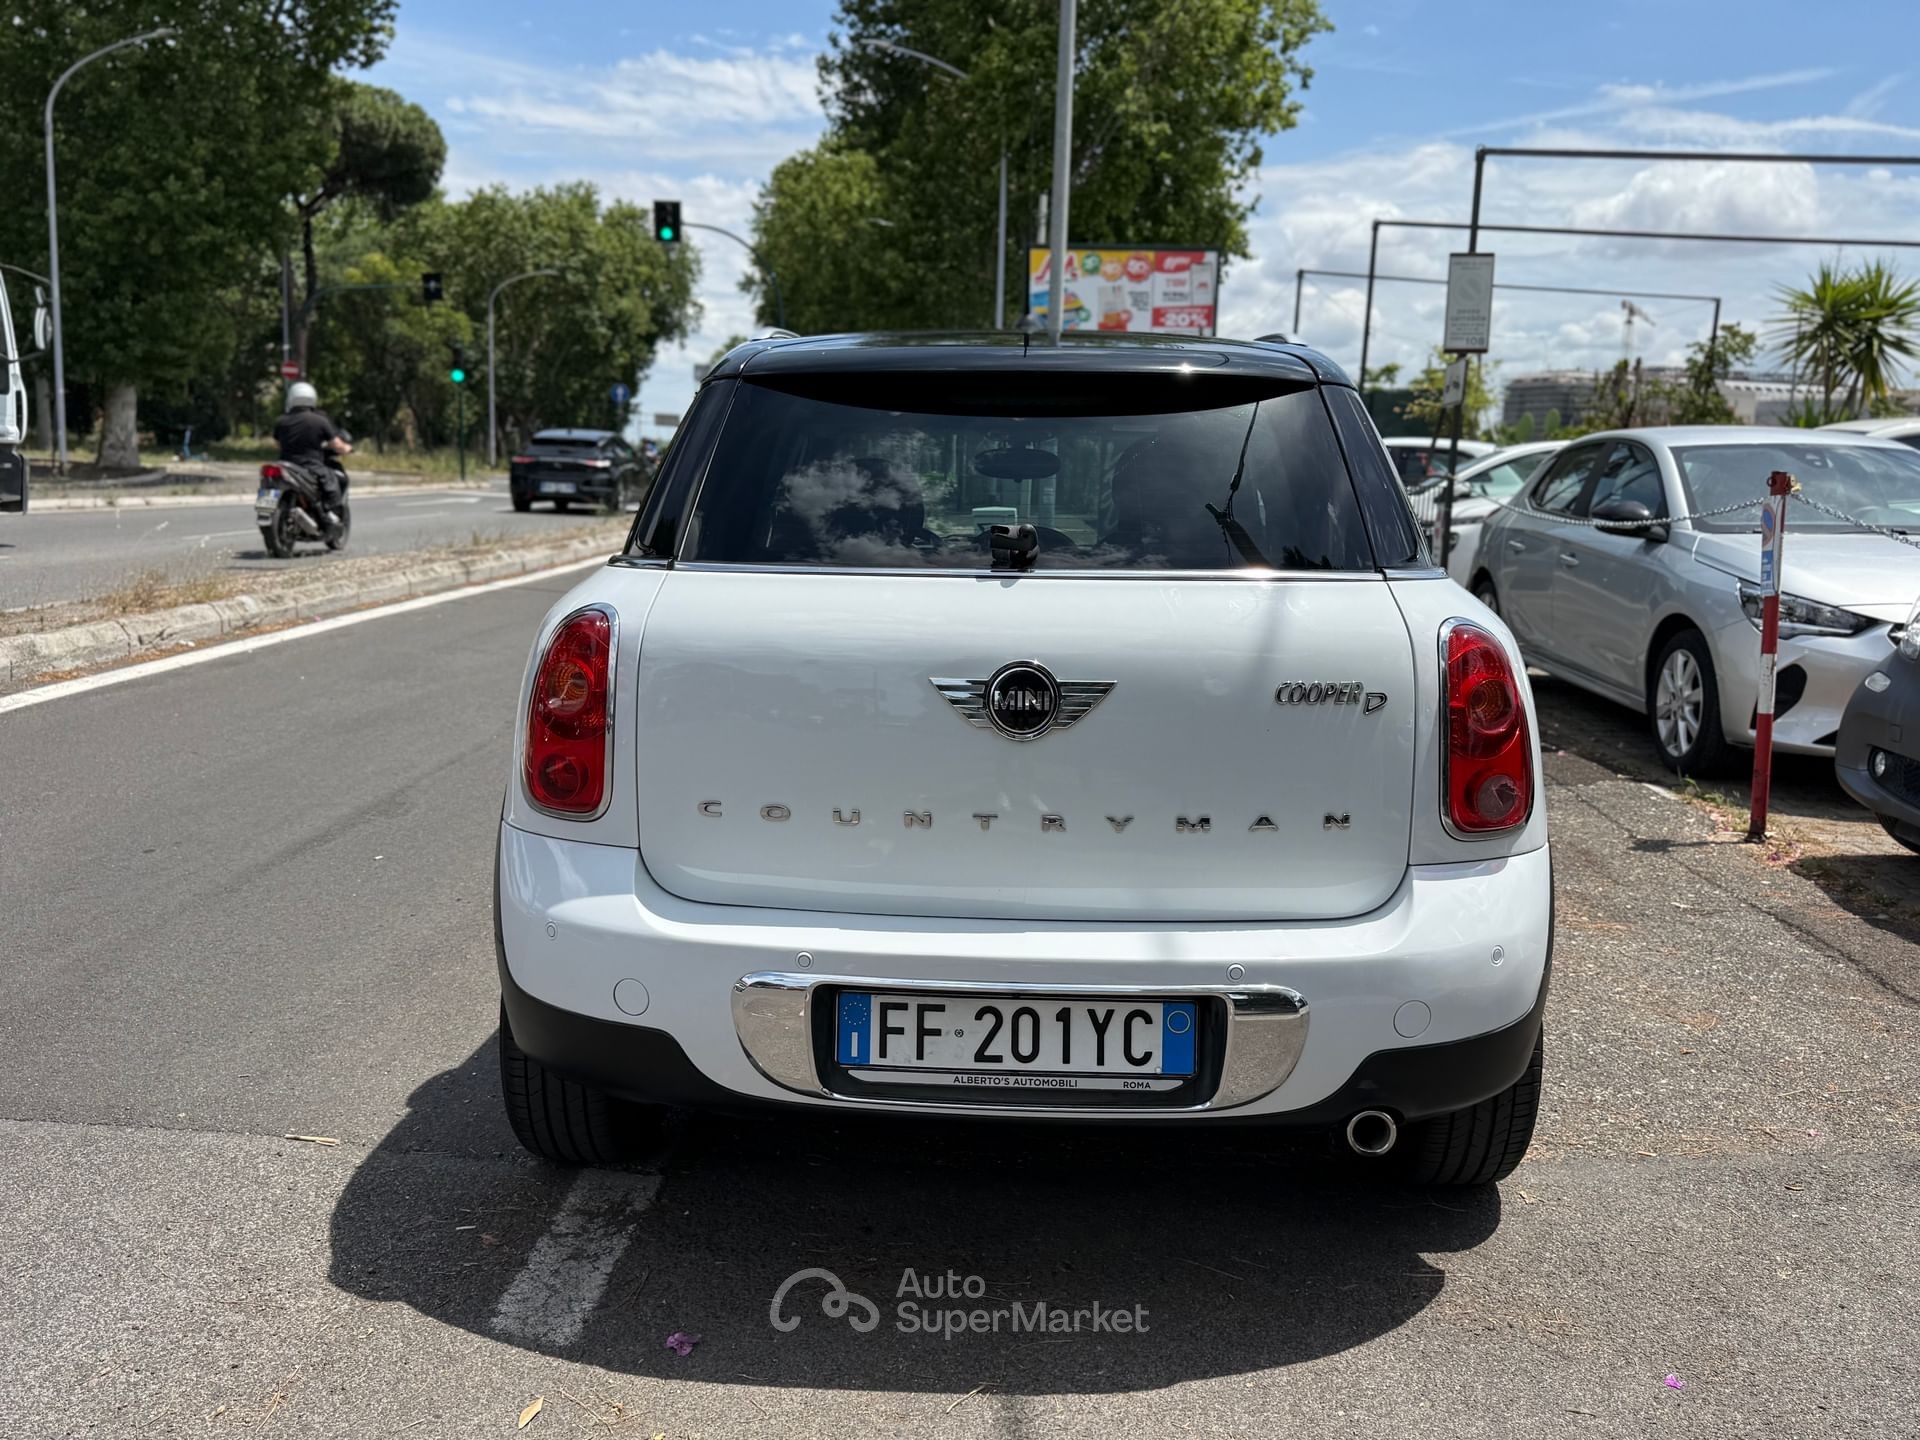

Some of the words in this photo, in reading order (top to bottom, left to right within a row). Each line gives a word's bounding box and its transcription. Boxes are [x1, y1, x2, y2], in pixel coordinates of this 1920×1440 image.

[994, 690, 1050, 711] MINI
[1275, 680, 1364, 706] COOPER
[1363, 692, 1388, 715] D
[696, 799, 1352, 833] COUNTRYMAN
[878, 1001, 946, 1060] FF
[973, 1005, 1154, 1066] 201YC
[953, 1076, 1010, 1086] ALBERTO'S
[1013, 1077, 1078, 1088] AUTOMOBILI
[1123, 1081, 1151, 1090] ROMA
